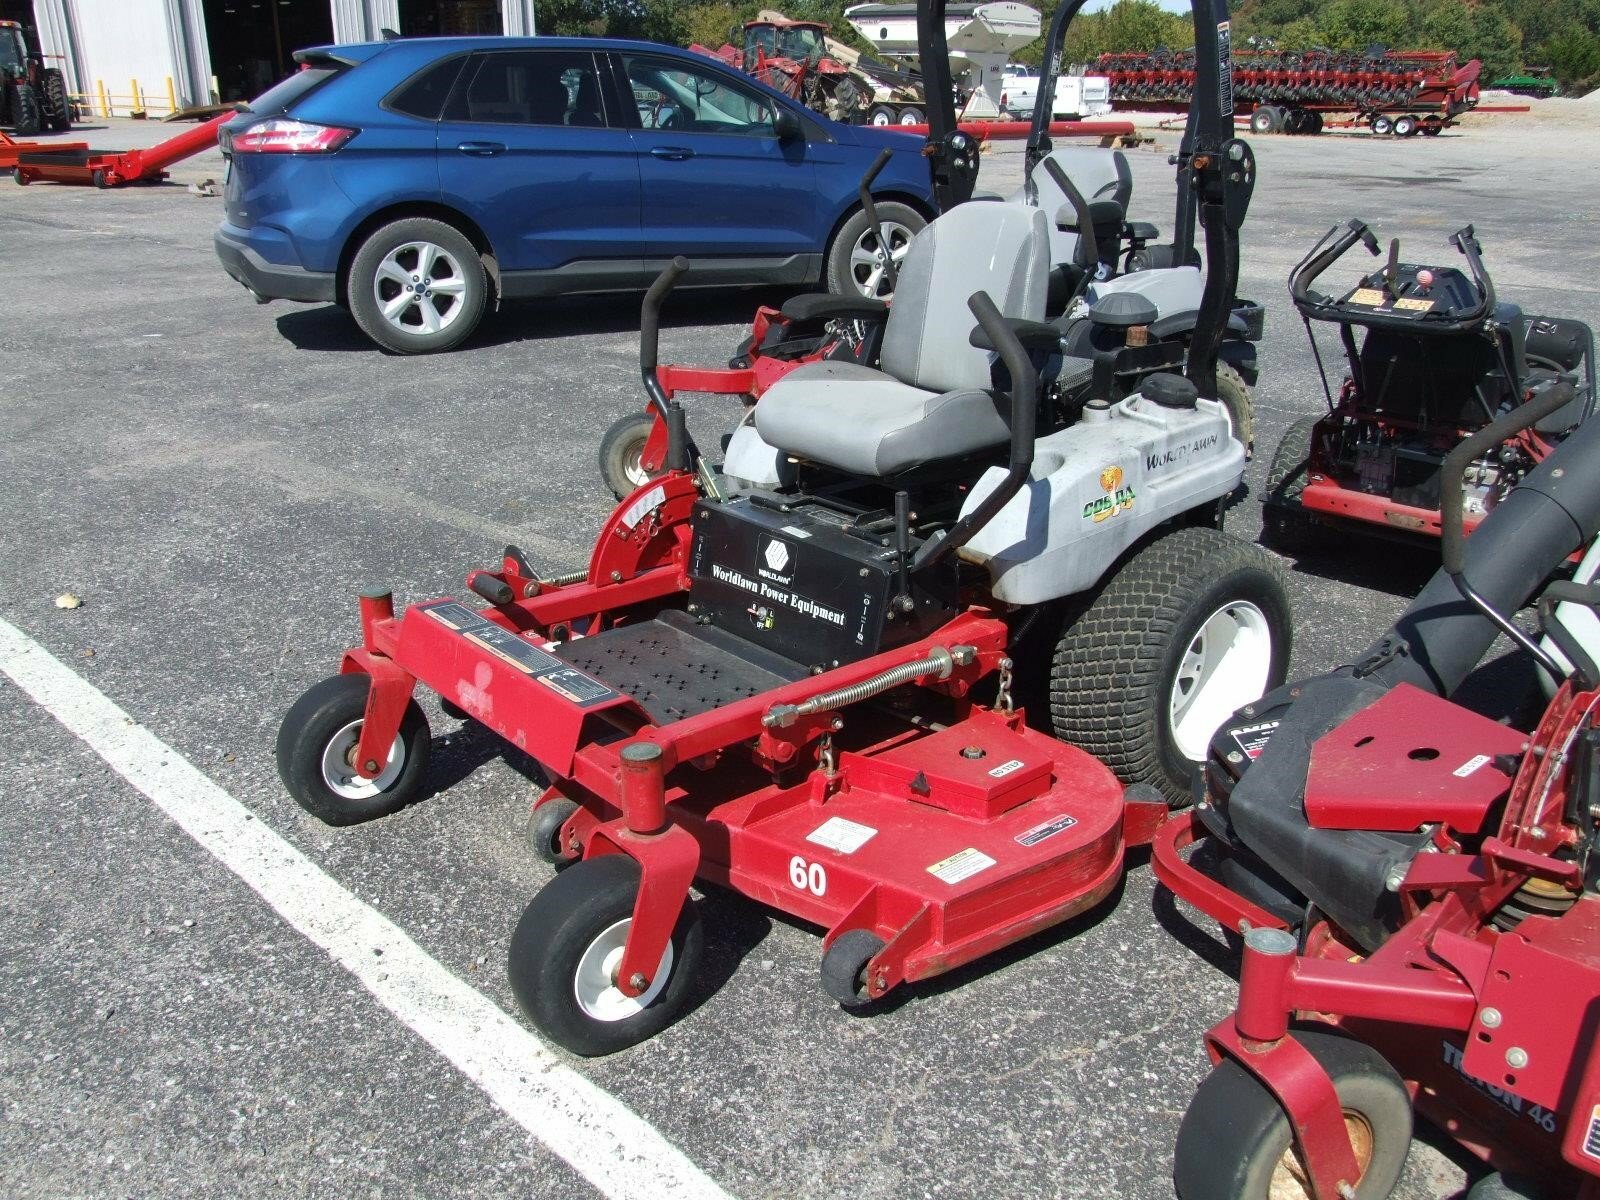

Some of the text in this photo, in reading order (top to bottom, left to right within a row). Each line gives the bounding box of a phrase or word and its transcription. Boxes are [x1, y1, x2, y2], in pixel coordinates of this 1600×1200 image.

[712, 564, 758, 593] Worldlawn
[759, 582, 788, 604] Power
[790, 594, 845, 626] Equipment
[790, 855, 827, 897] 60
[1527, 1104, 1556, 1133] 46
